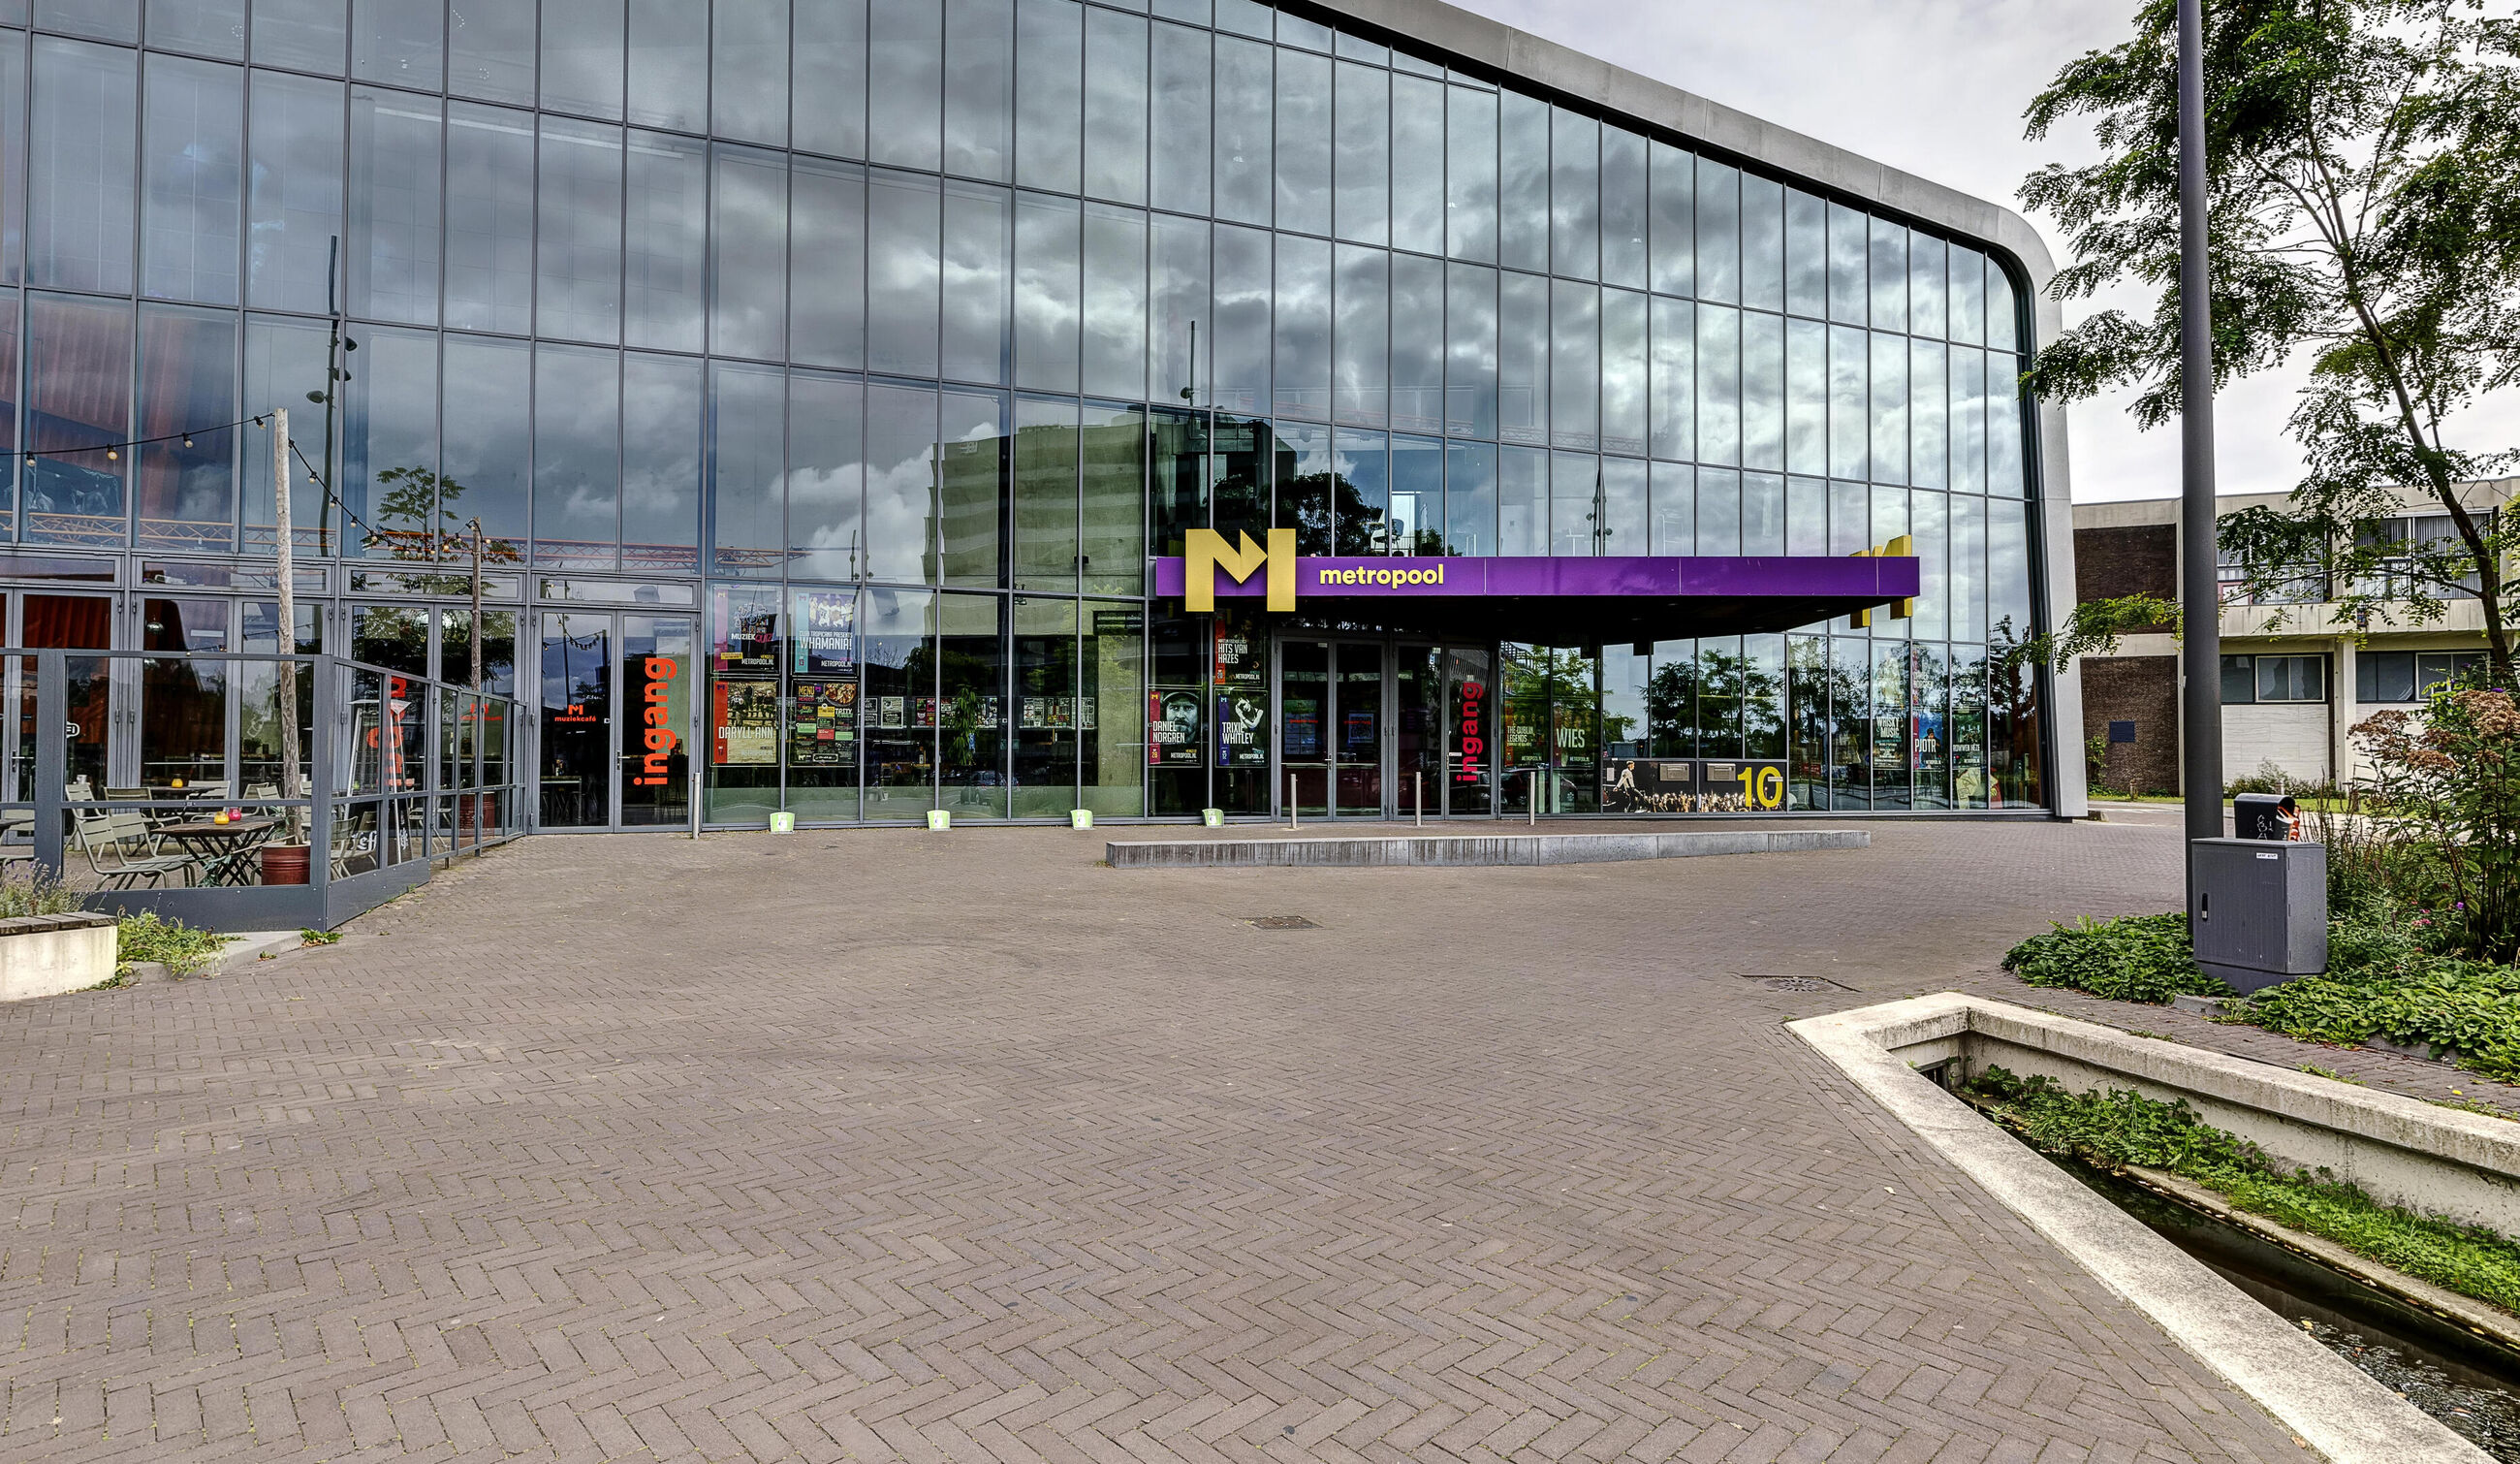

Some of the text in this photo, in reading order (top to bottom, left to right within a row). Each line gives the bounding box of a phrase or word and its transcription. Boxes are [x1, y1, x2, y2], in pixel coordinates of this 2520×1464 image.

[1319, 563, 1444, 589] metropool
[731, 632, 755, 641] MUZIEK
[800, 636, 853, 651] WHAMANIA!
[1218, 643, 1248, 654] HITS VAN
[1218, 653, 1239, 664] HAZES
[798, 685, 815, 695] MENU
[633, 657, 677, 785] ingang
[1153, 720, 1178, 732] DANIEL
[1876, 716, 1900, 728] WHISKY
[1222, 721, 1245, 734] TRIXIE
[1456, 682, 1484, 781] ingang
[1880, 726, 1900, 738] MUSIC
[1153, 732, 1185, 744] NORGREN
[1222, 732, 1254, 745] WHITLEY
[1557, 727, 1586, 748] WIES
[1737, 766, 1783, 808] 10
